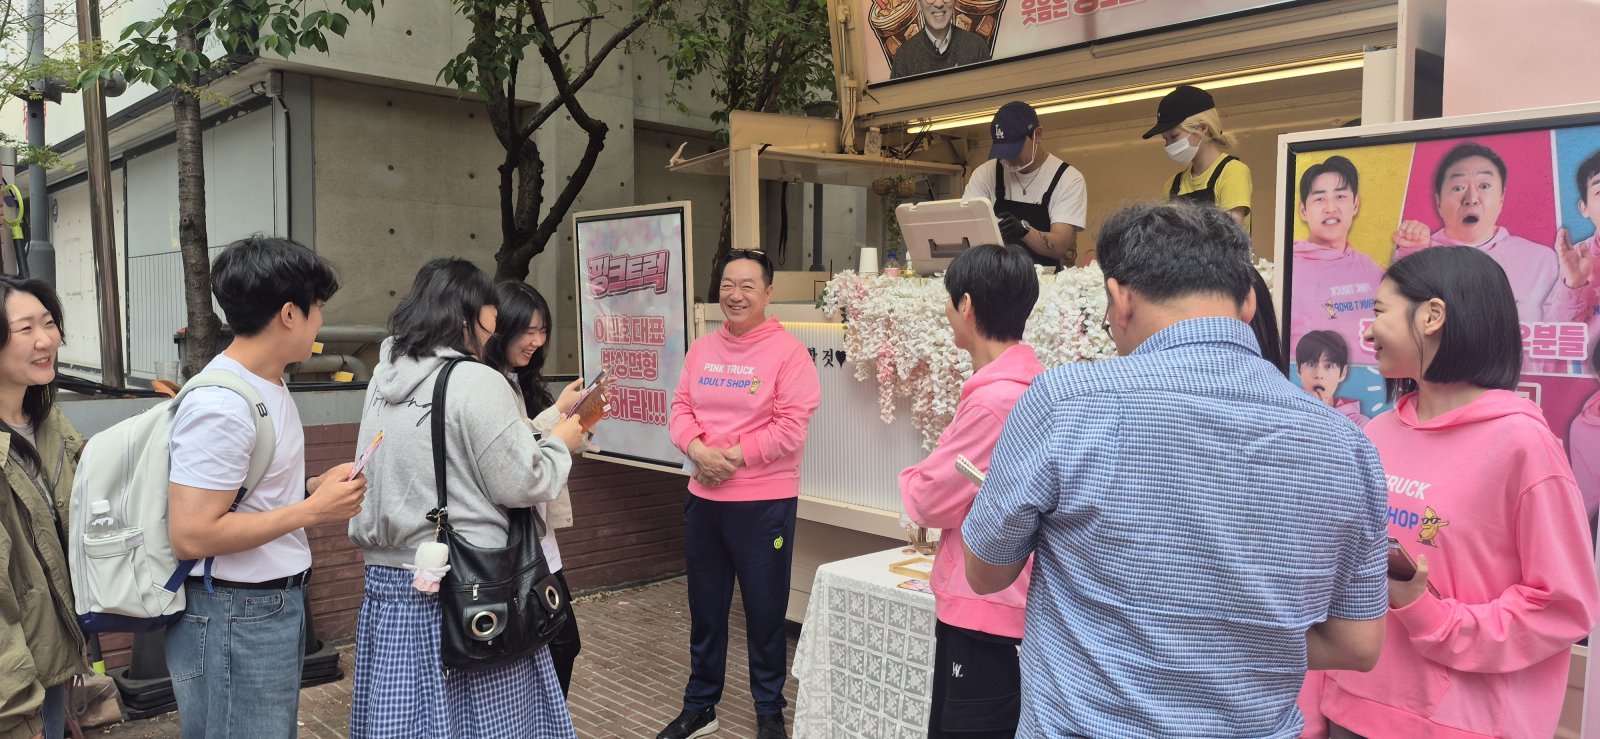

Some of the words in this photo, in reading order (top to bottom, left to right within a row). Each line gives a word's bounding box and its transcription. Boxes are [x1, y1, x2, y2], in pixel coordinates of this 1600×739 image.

[995, 124, 1004, 139] LA
[587, 250, 669, 299] 핑크트럭
[595, 315, 630, 345] 이민호
[632, 316, 665, 345] 대표
[601, 349, 658, 381] 박상면형
[703, 362, 726, 374] PINK
[727, 364, 756, 375] TRUCK
[698, 376, 727, 387] ADULT
[726, 379, 751, 389] SHOP
[601, 384, 667, 426] 해라!!!
[1388, 506, 1419, 530] HOP
